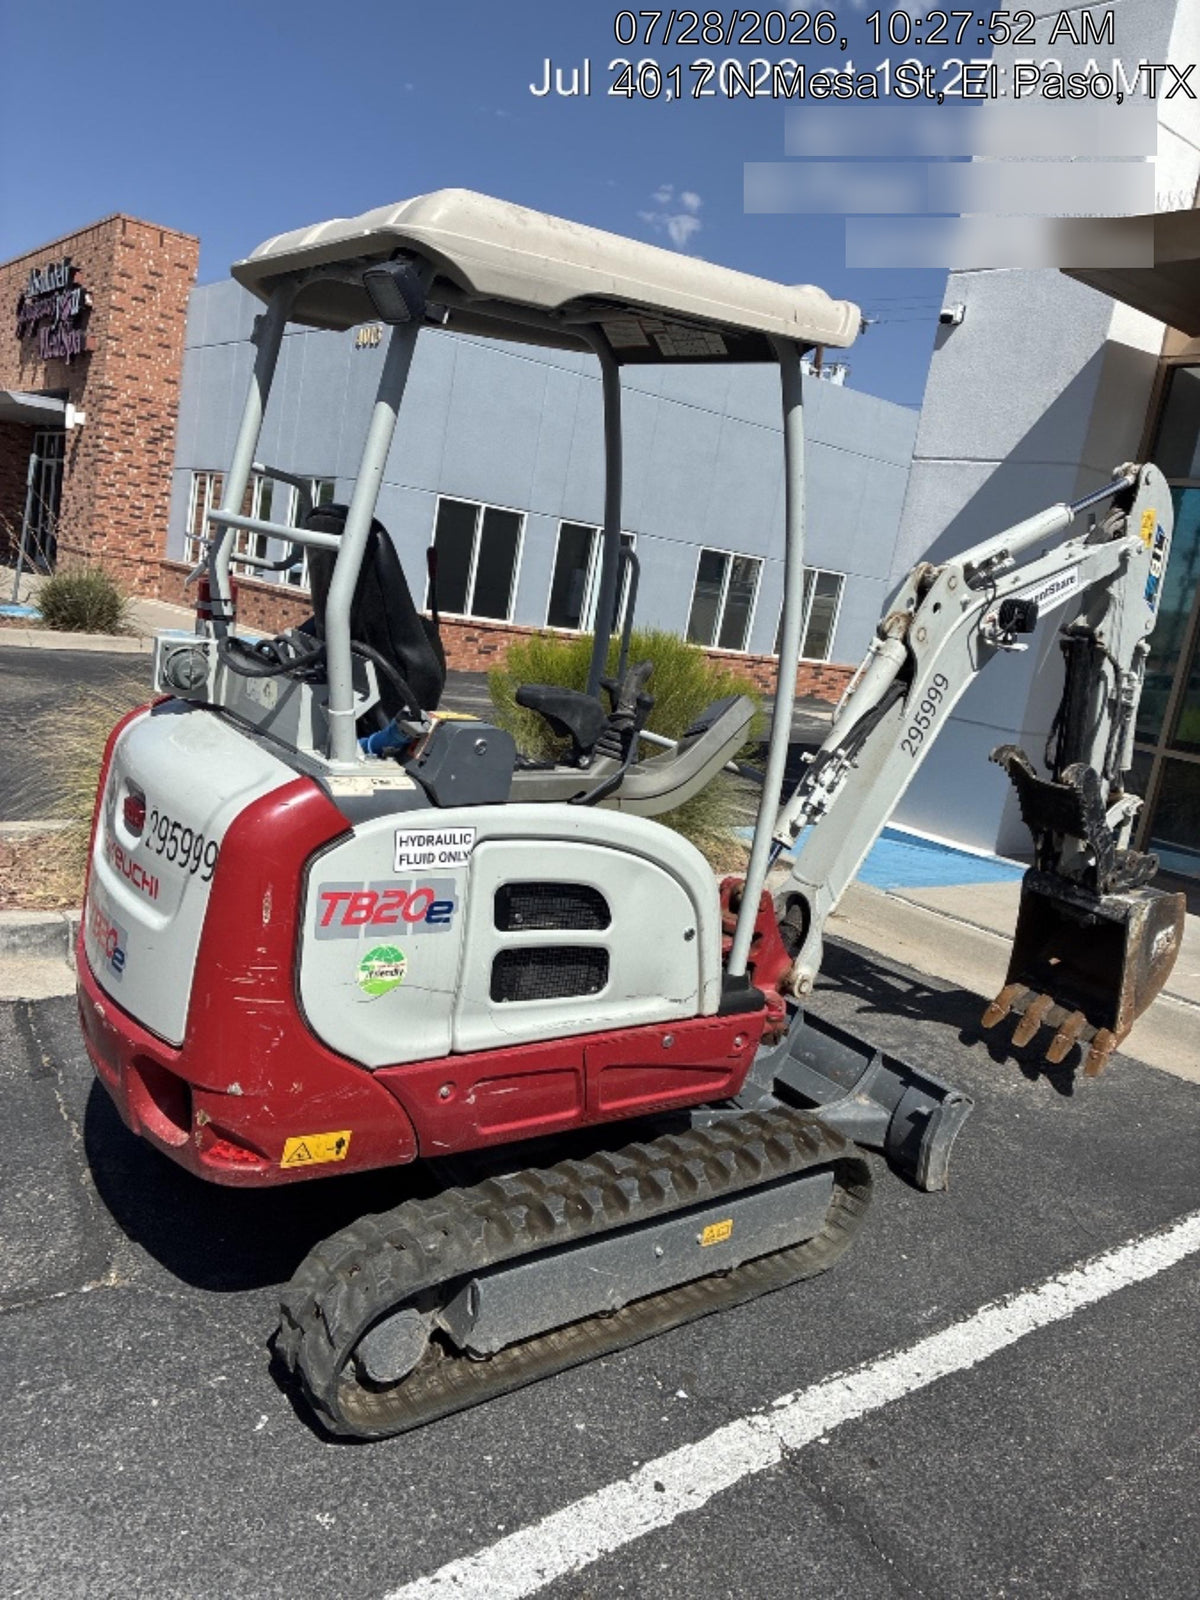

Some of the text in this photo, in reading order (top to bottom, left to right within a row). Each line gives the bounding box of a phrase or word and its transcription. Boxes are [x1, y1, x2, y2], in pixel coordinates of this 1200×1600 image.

[901, 672, 949, 758] 295999
[145, 808, 222, 883] 295999
[399, 833, 473, 848] HYDRAULIC
[399, 850, 472, 866] FLUID ONLY
[319, 887, 454, 927] TB20e
